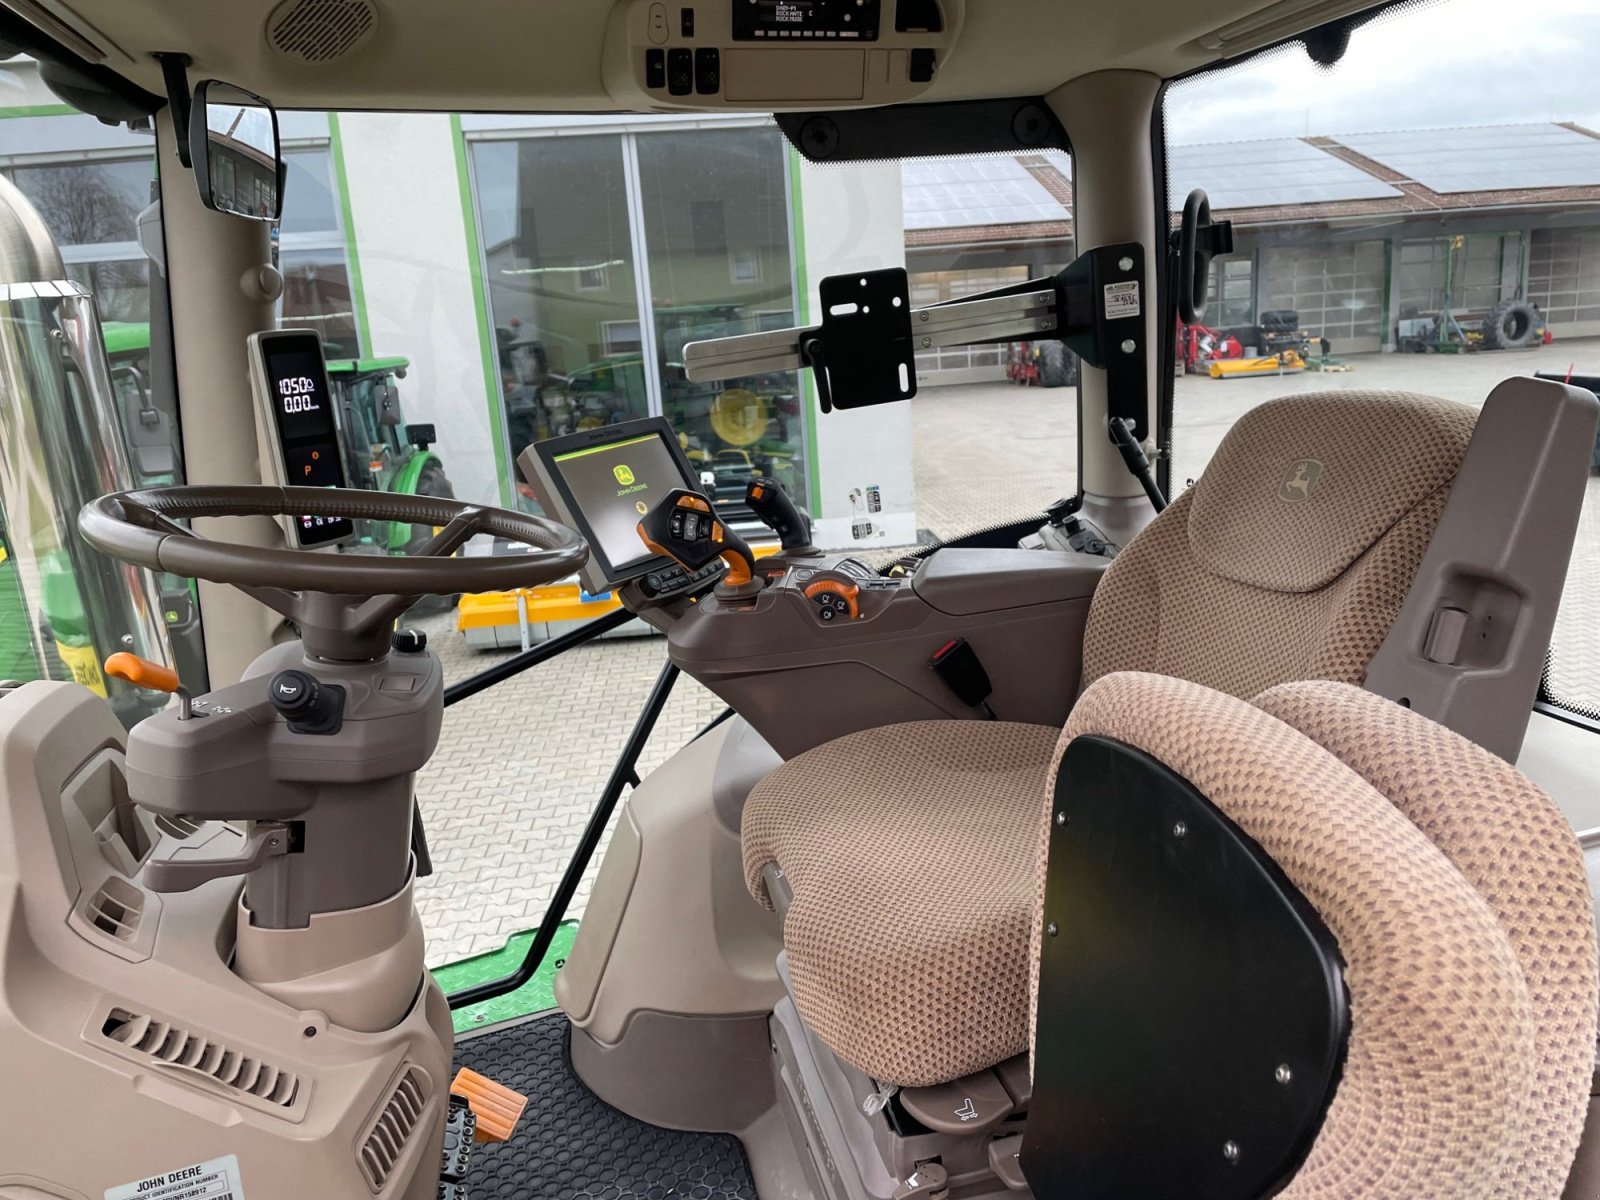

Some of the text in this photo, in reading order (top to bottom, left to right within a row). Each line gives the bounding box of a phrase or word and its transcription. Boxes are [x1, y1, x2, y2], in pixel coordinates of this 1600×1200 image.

[279, 377, 308, 395] 1050
[136, 1165, 203, 1193] JOHN DEERE
[195, 1173, 219, 1185] NUMBER
